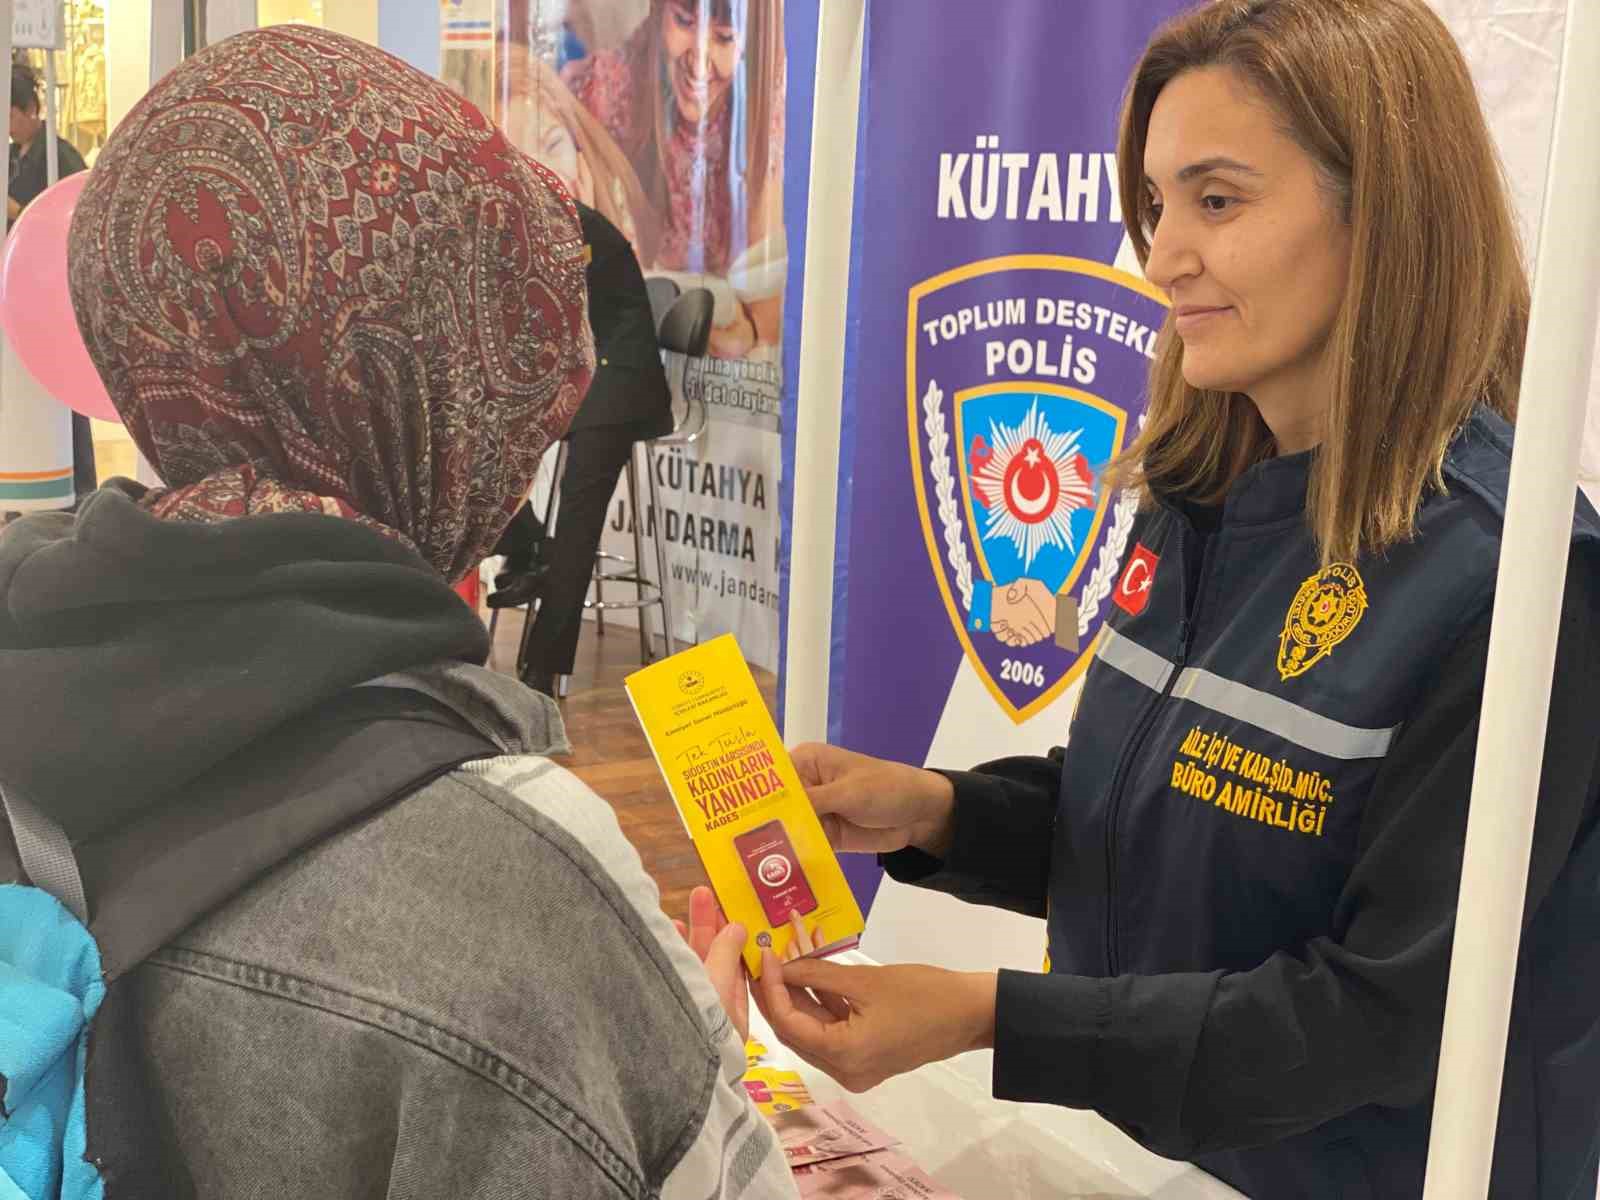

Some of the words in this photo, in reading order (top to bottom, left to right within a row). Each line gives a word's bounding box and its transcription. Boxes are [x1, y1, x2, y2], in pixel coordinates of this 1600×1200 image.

[923, 299, 1026, 346] TOPLUM
[985, 335, 1097, 384] POLİS
[655, 447, 766, 510] KÜTAHYA
[1000, 658, 1045, 688] 2006
[687, 748, 775, 799] KADINLARIN
[1221, 742, 1243, 772] VE
[695, 767, 785, 820] YANINDA
[1171, 761, 1217, 801] BÜRO
[1214, 779, 1327, 836] AMİRLİĞİ
[704, 811, 740, 832] KADES
